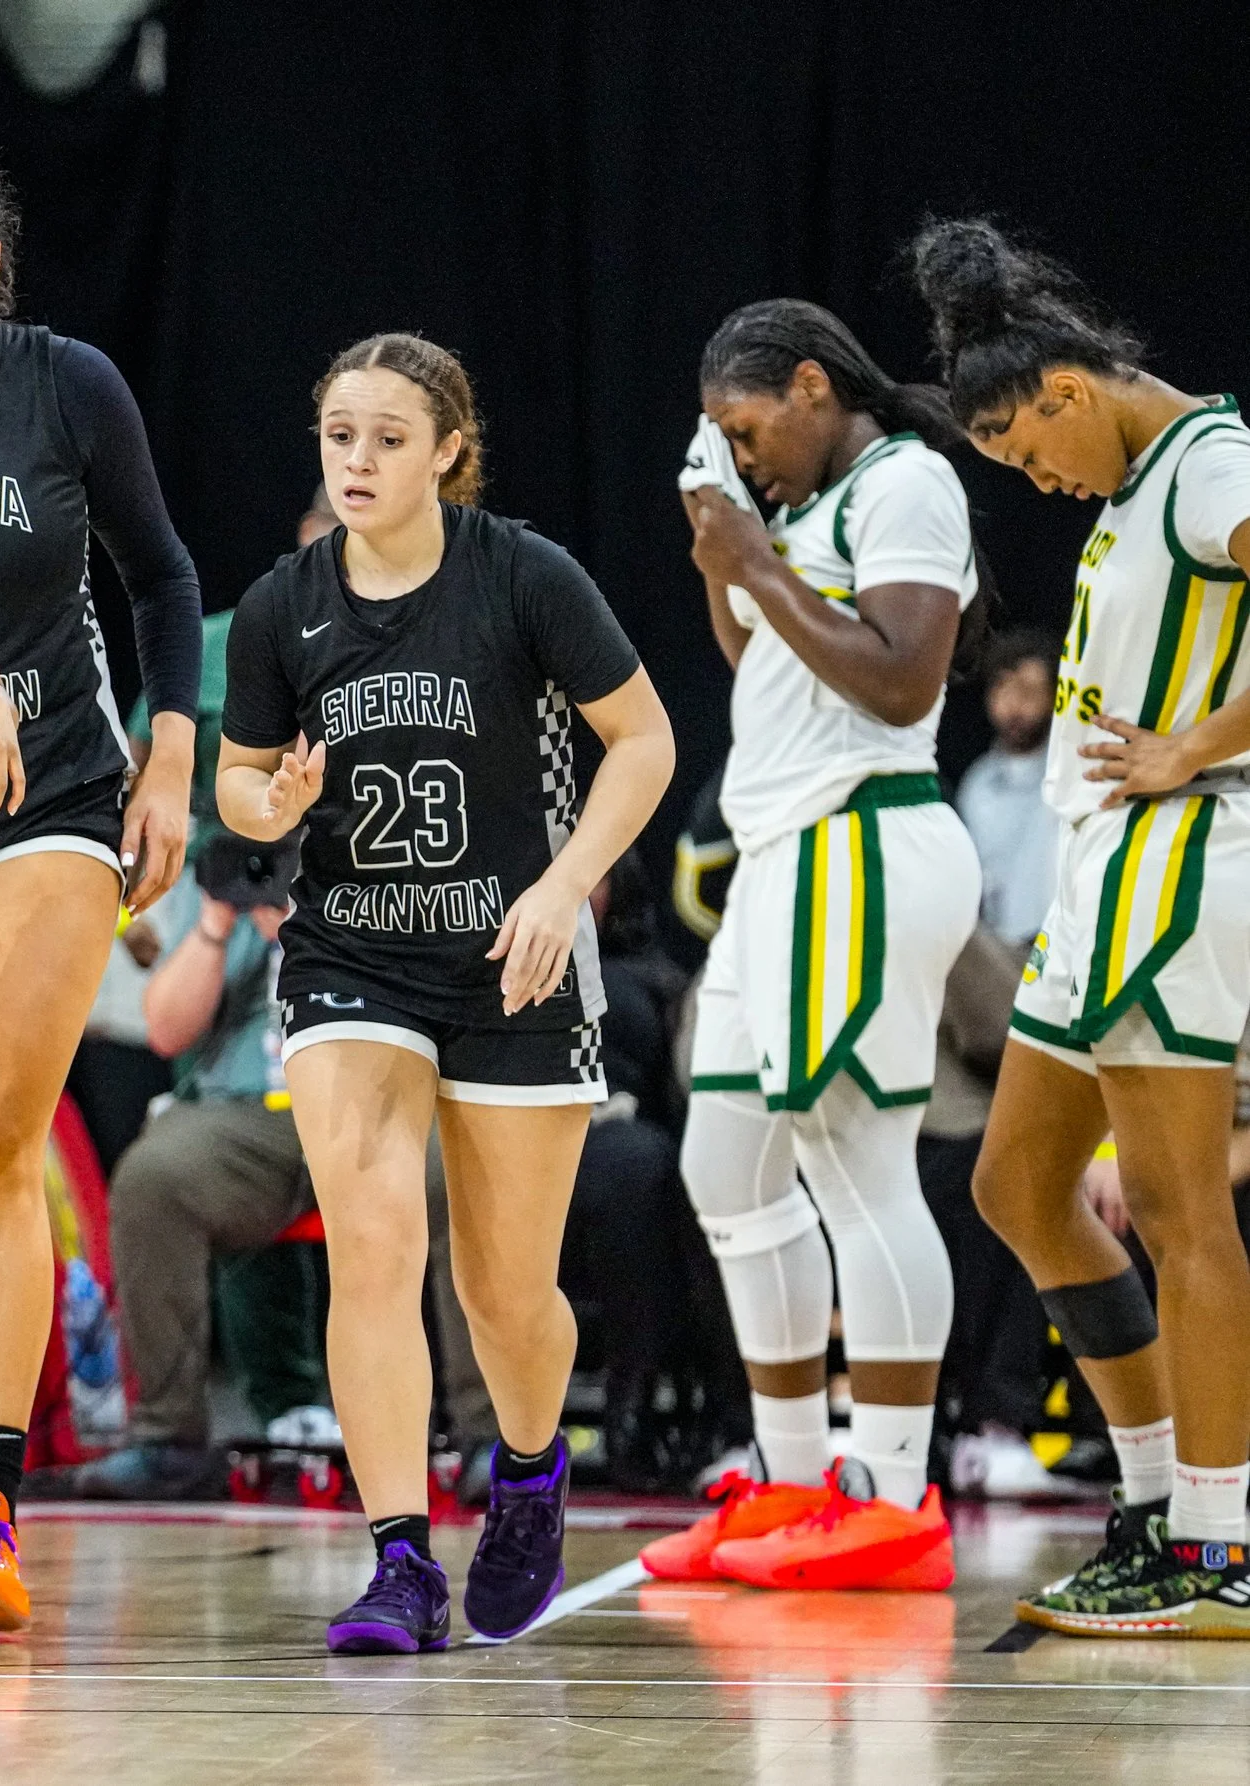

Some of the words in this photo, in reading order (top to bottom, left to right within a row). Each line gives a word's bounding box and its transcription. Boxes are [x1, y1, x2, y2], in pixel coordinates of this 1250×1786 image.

[321, 671, 477, 746] SIERRA
[350, 759, 468, 870] 23
[324, 876, 505, 933] CANYON
